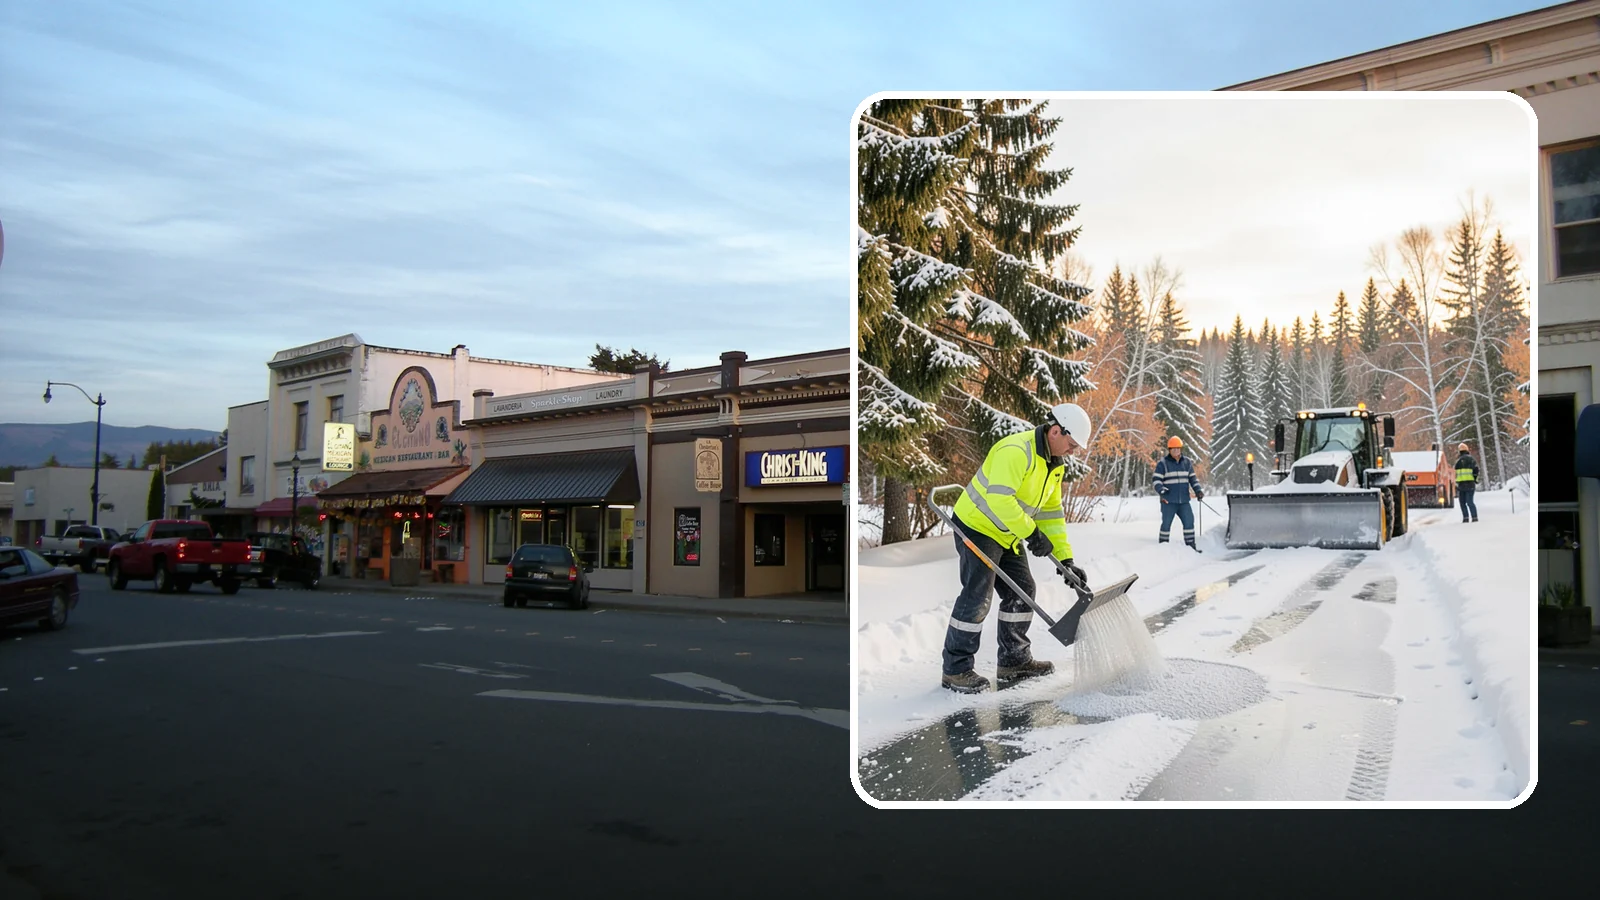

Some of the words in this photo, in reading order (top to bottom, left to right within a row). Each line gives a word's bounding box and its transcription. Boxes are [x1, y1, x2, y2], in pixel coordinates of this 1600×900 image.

[562, 394, 582, 404] Shop
[595, 389, 624, 400] LAUNDRY
[493, 402, 523, 413] LAVANDERIA
[373, 455, 396, 464] MEXICAN
[397, 451, 433, 462] RESTAURANT
[438, 450, 450, 459] BAR
[761, 452, 797, 478] CHRIST
[799, 450, 828, 476] KING
[696, 481, 709, 489] Coffee
[710, 481, 721, 489] House
